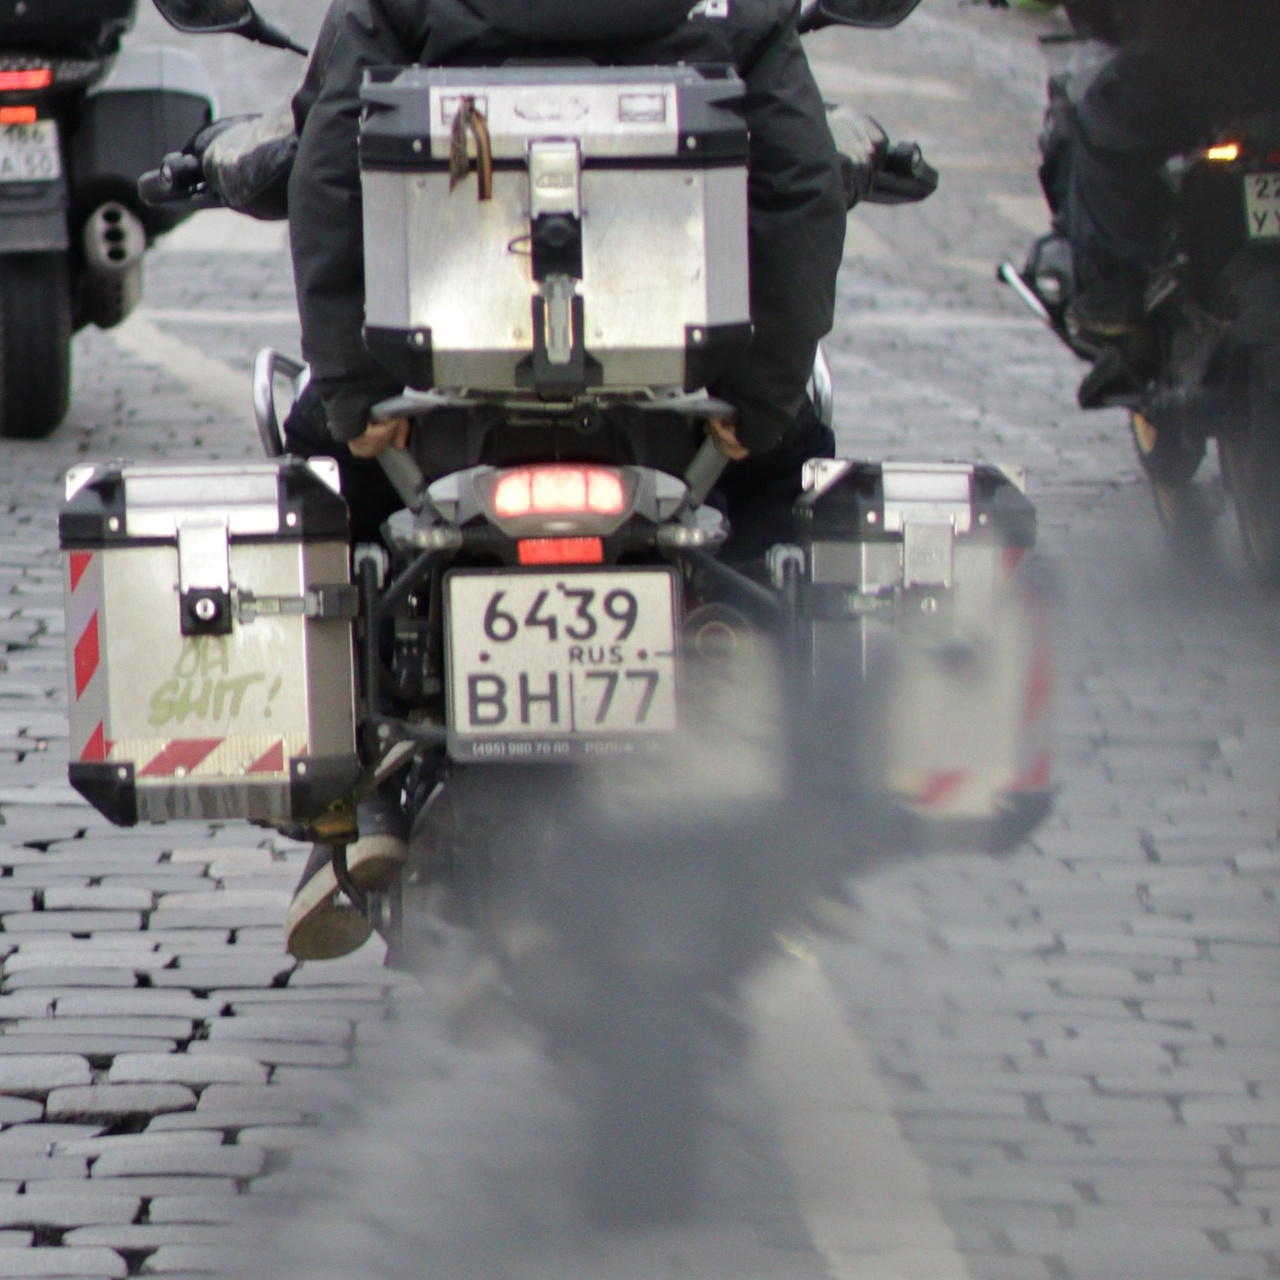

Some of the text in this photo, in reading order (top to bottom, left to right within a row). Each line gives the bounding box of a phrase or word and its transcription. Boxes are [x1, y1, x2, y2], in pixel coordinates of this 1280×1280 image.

[483, 588, 639, 642] 6439
[569, 646, 624, 664] RUS
[585, 671, 660, 724] 77
